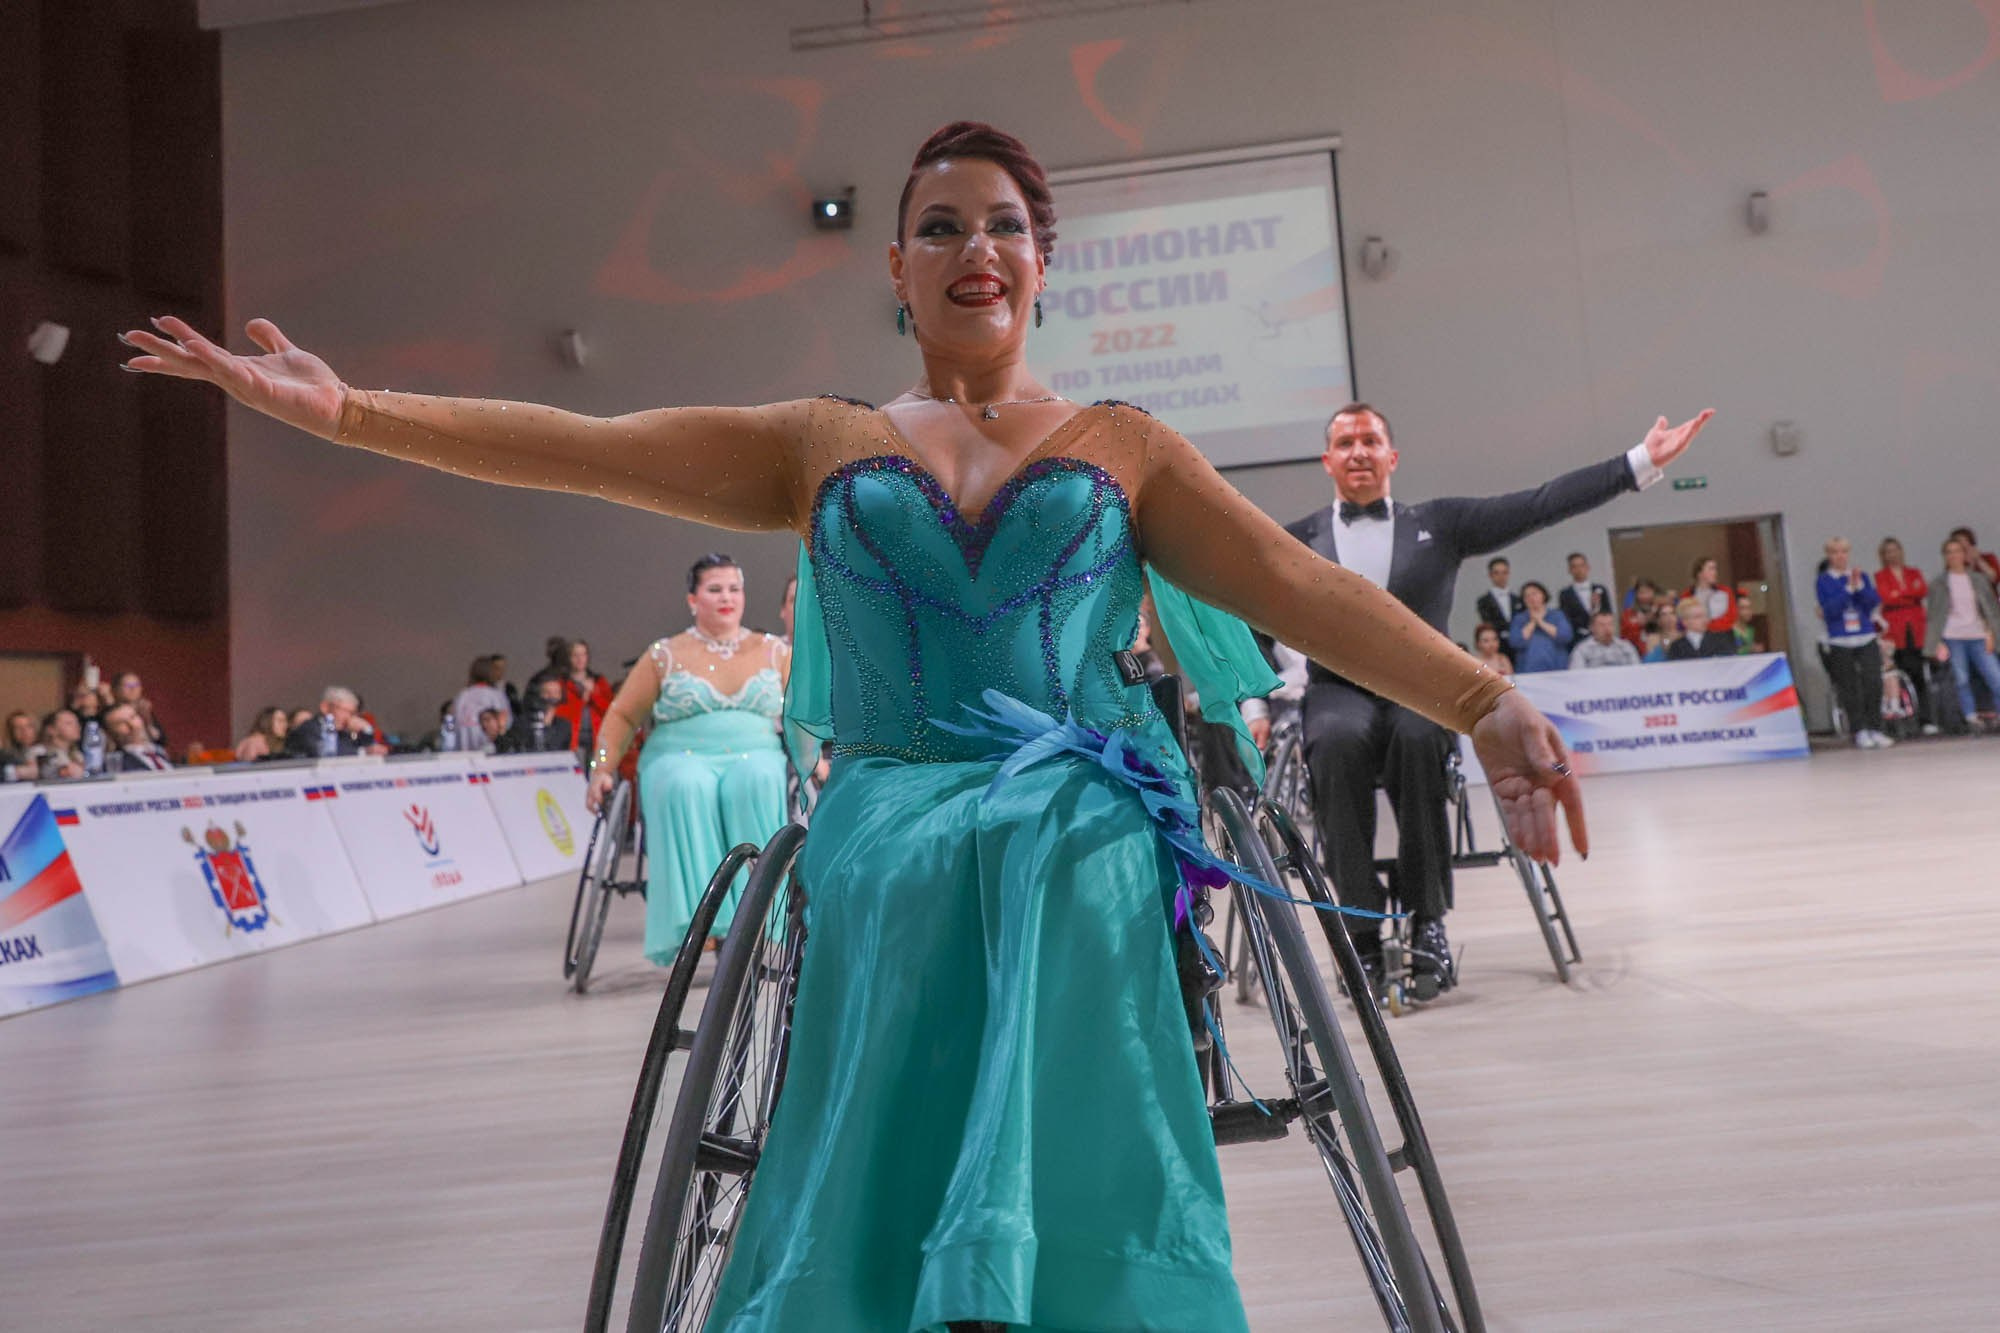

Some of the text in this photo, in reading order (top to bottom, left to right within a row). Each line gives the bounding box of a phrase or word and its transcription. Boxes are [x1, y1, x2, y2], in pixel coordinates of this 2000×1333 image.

[1090, 323, 1177, 355] 2022
[1051, 354, 1223, 391] ПО ТАНЦАМ
[1565, 686, 1748, 714] ЧЕМПИОНАТ РОССИИ
[1643, 713, 1678, 728] 2022
[1596, 735, 1655, 752] ТАНЦАМ
[1659, 733, 1679, 745] НА
